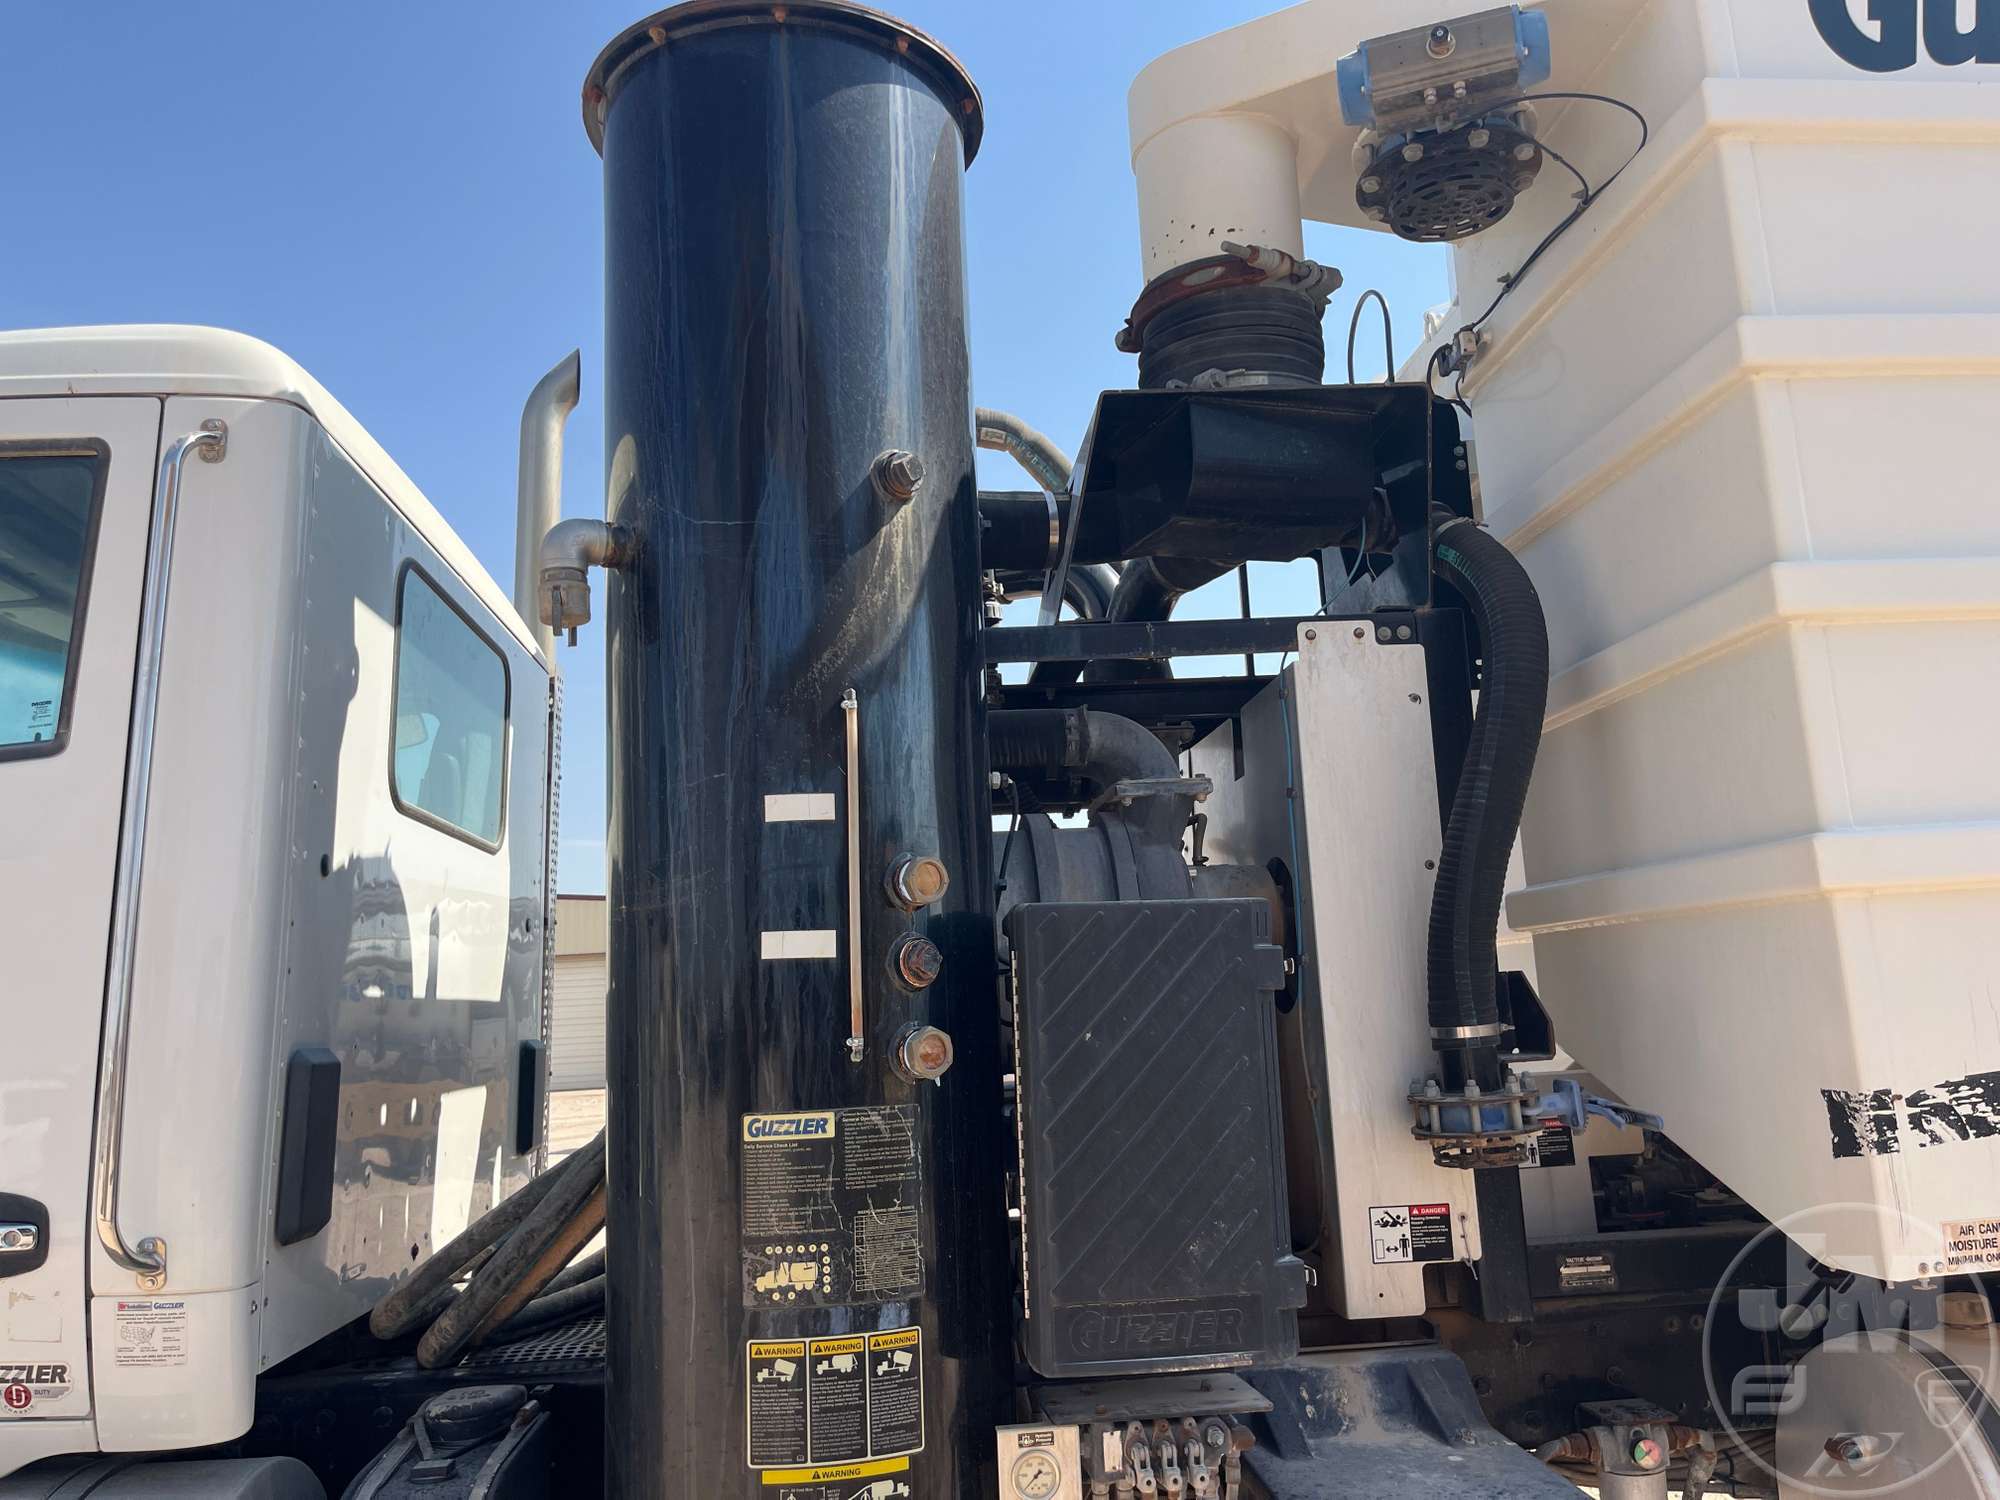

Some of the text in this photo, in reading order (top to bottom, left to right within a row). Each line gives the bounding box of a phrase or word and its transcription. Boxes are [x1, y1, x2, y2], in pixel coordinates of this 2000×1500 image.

[747, 1117, 829, 1138] GUZZLER
[1959, 1225, 1975, 1236] AIR
[1948, 1237, 1998, 1252] MOISTURE
[1947, 1254, 1984, 1266] MINIMUM
[1070, 1307, 1244, 1356] GUZZLER
[880, 1334, 917, 1346] WARNING
[763, 1346, 803, 1356] WARNING
[823, 1342, 862, 1352] WARNING
[821, 1467, 861, 1480] WARNING
